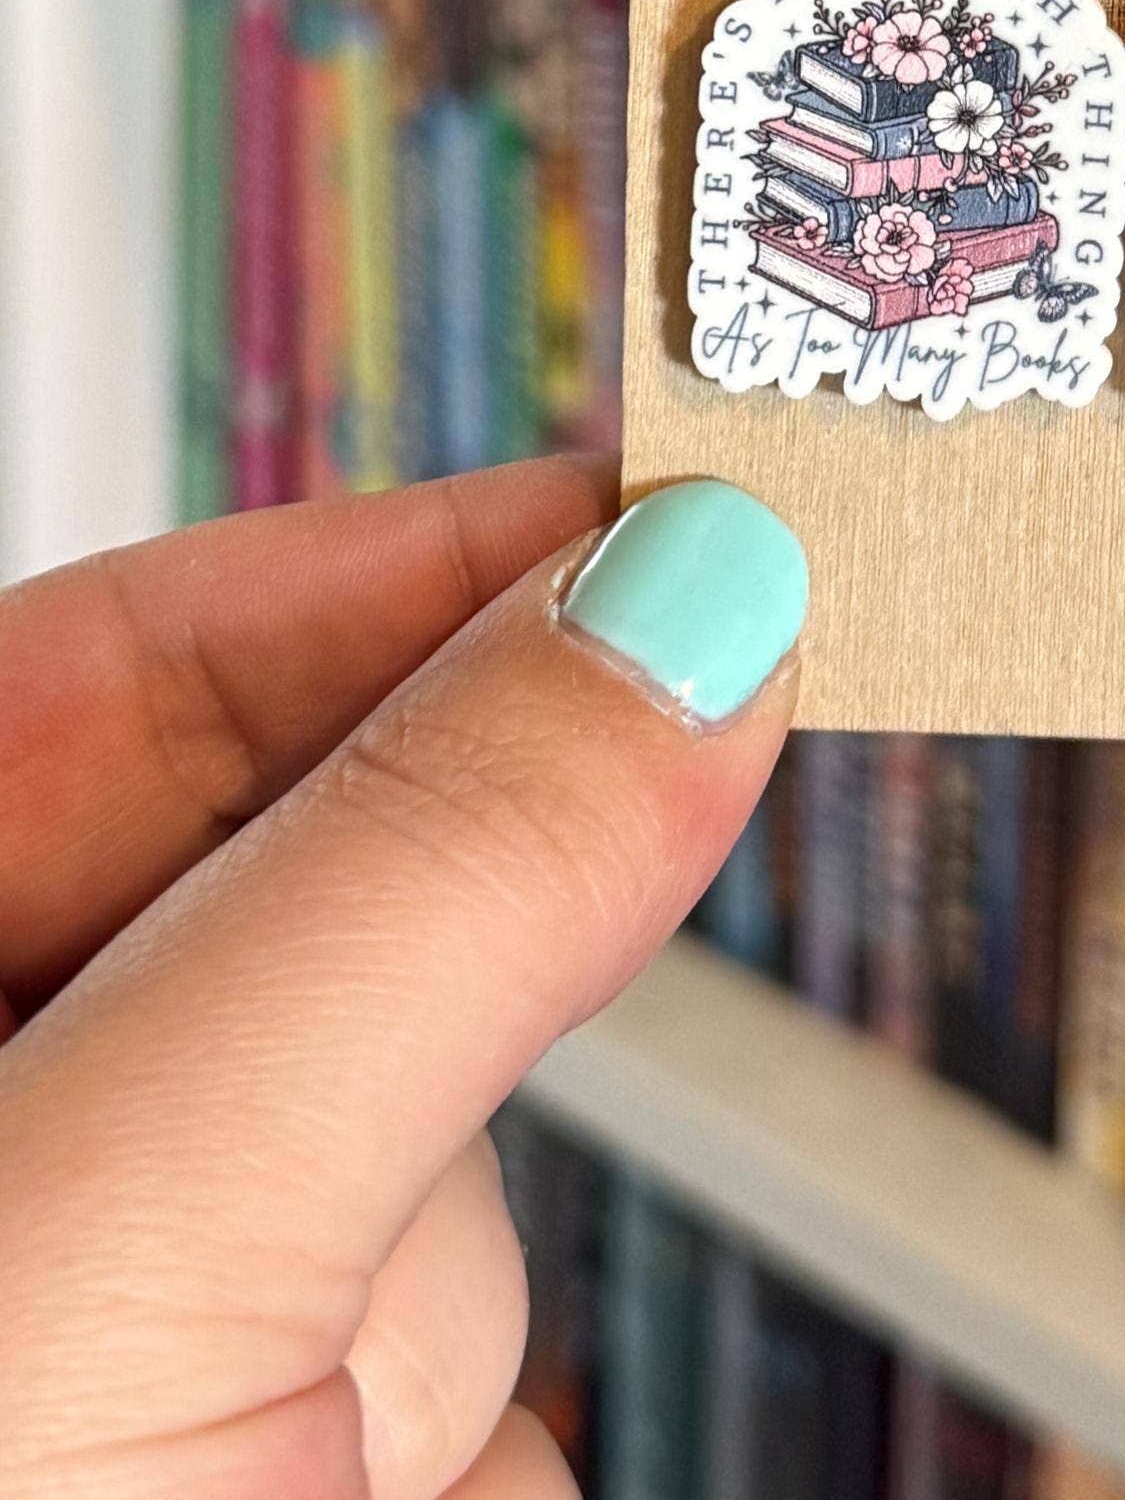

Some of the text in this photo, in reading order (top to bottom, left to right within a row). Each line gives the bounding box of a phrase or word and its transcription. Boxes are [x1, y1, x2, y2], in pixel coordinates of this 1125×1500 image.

[1075, 52, 1114, 266] THING
[701, 302, 1091, 402] As Too Many Books
